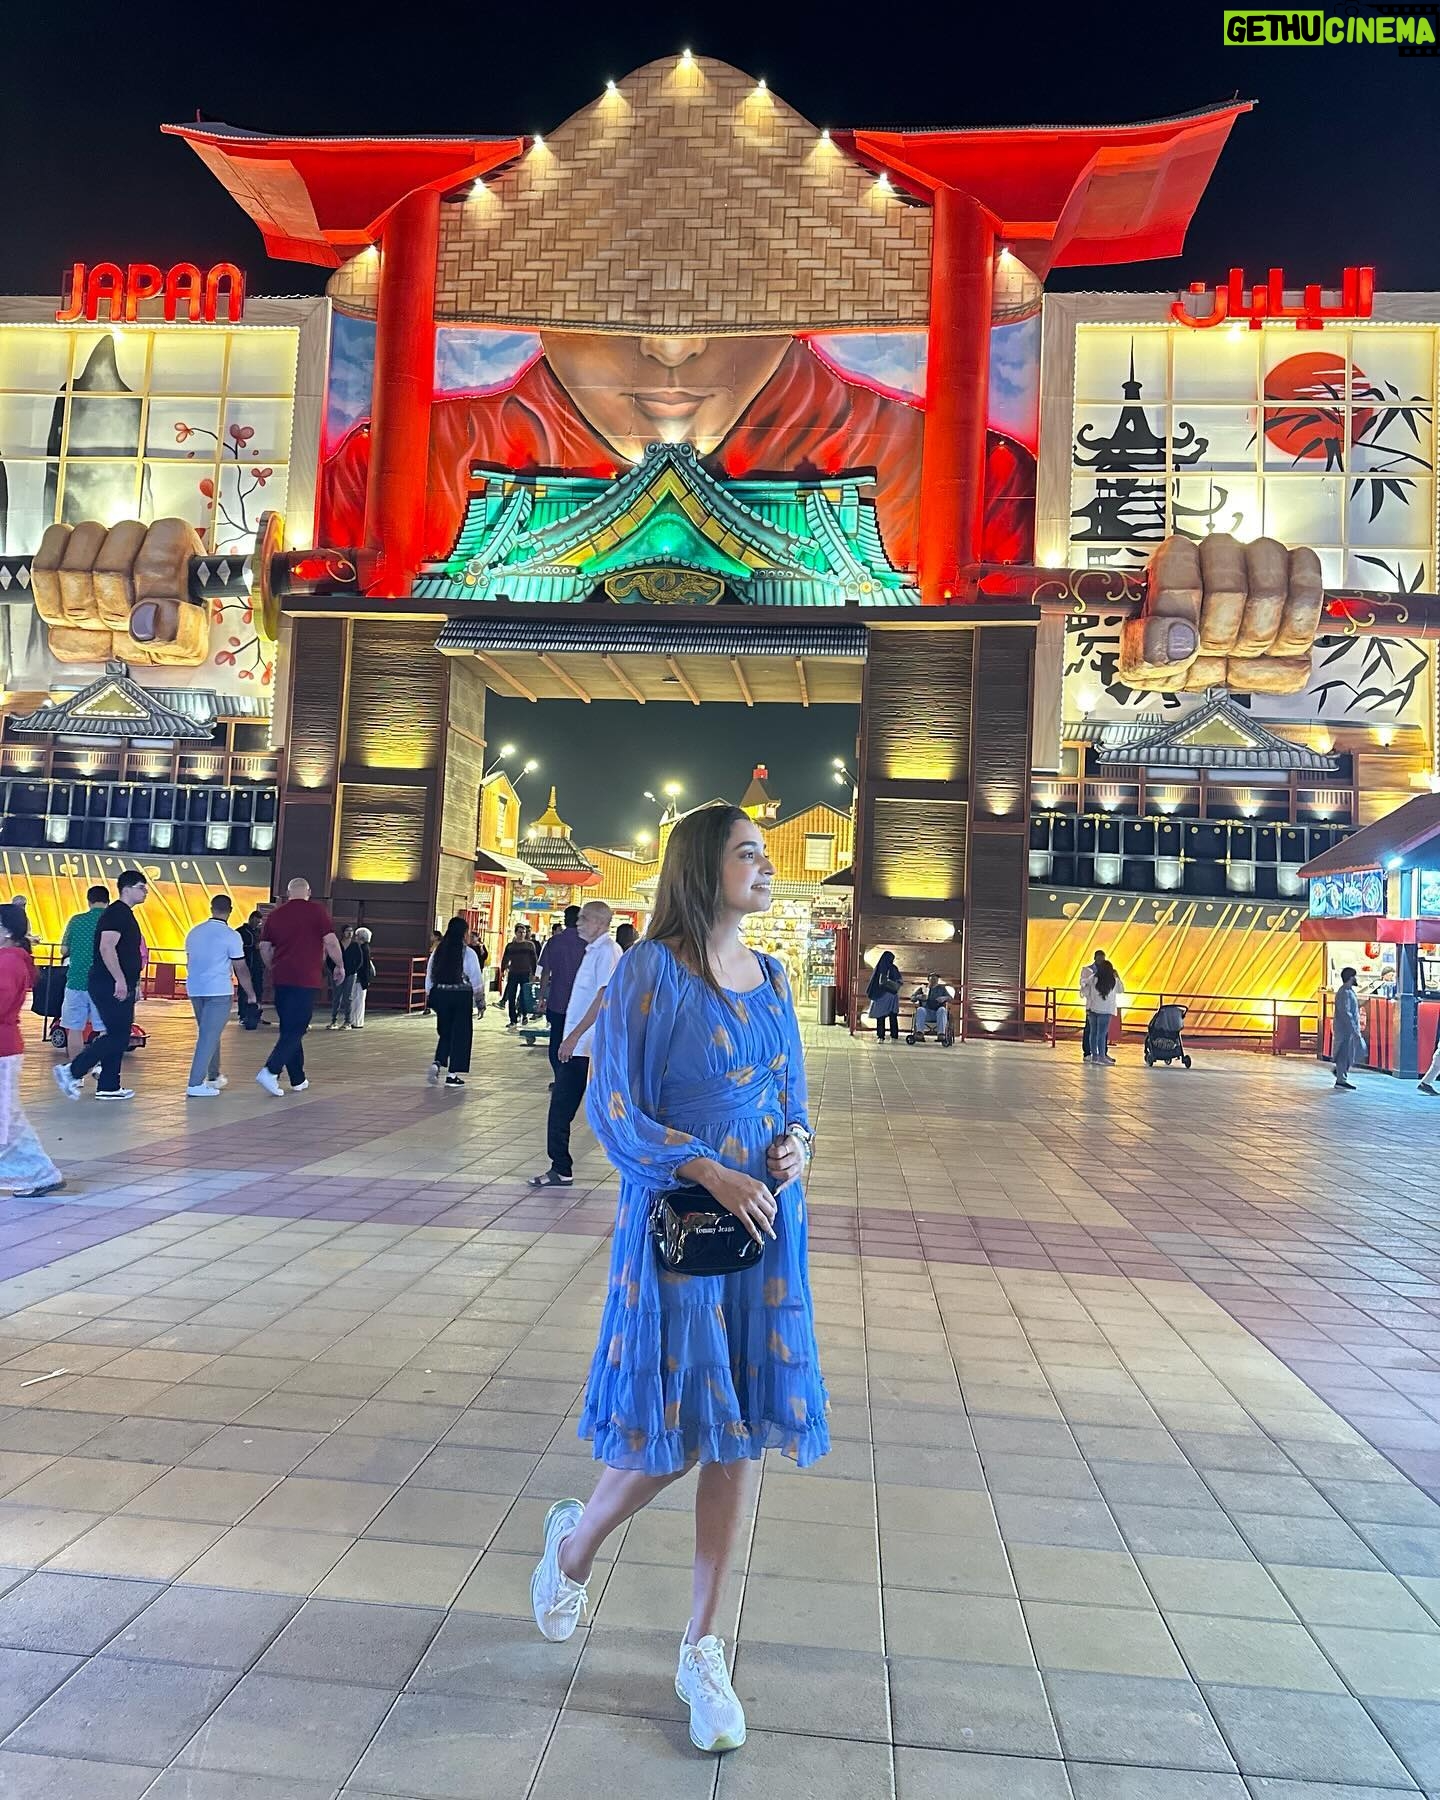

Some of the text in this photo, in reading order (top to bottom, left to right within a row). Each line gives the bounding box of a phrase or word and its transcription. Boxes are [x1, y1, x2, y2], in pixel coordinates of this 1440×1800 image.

[56, 263, 242, 323] JAPAN
[1171, 267, 1374, 330] اليابان
[718, 1225, 735, 1233] Jeans
